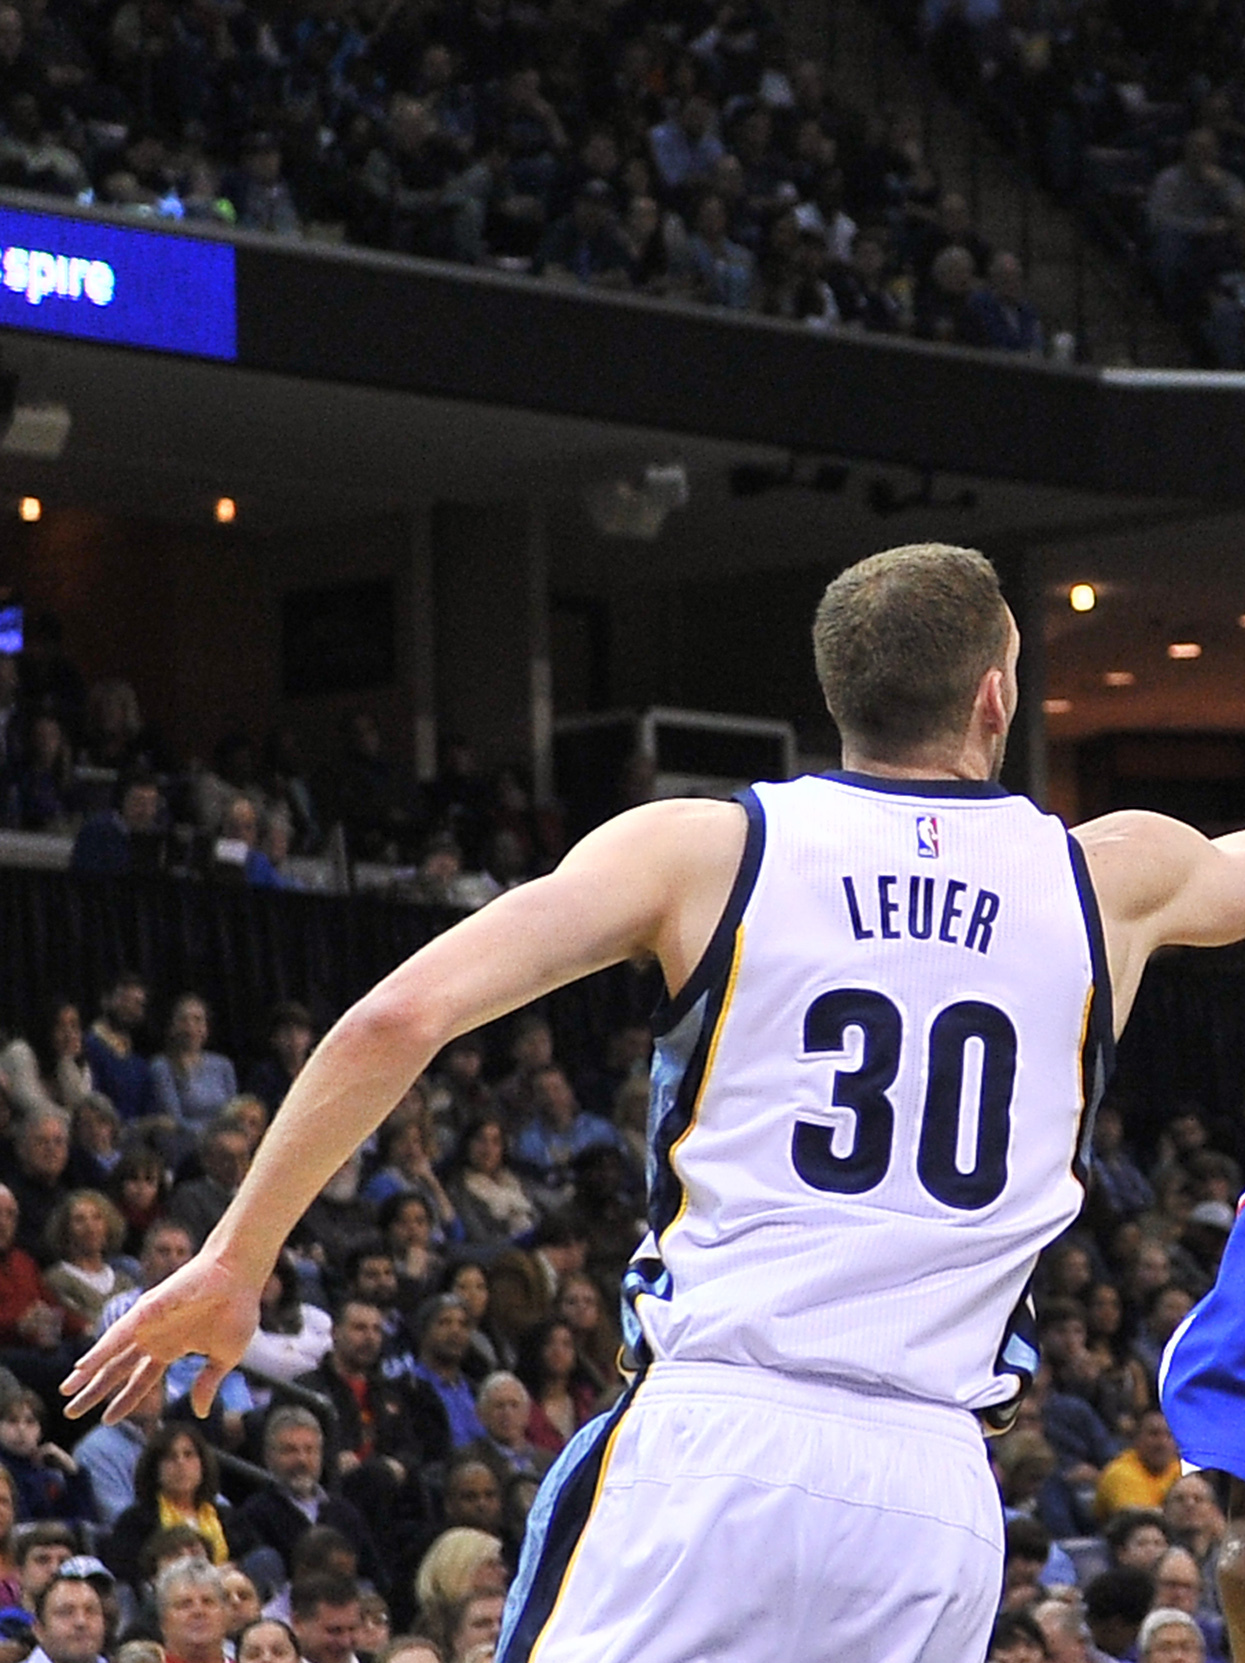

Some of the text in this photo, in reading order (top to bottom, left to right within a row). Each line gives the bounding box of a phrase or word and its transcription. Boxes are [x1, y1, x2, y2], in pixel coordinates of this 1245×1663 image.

[0, 246, 115, 306] spire
[841, 875, 1001, 955] LEUER
[790, 987, 1018, 1211] 30
